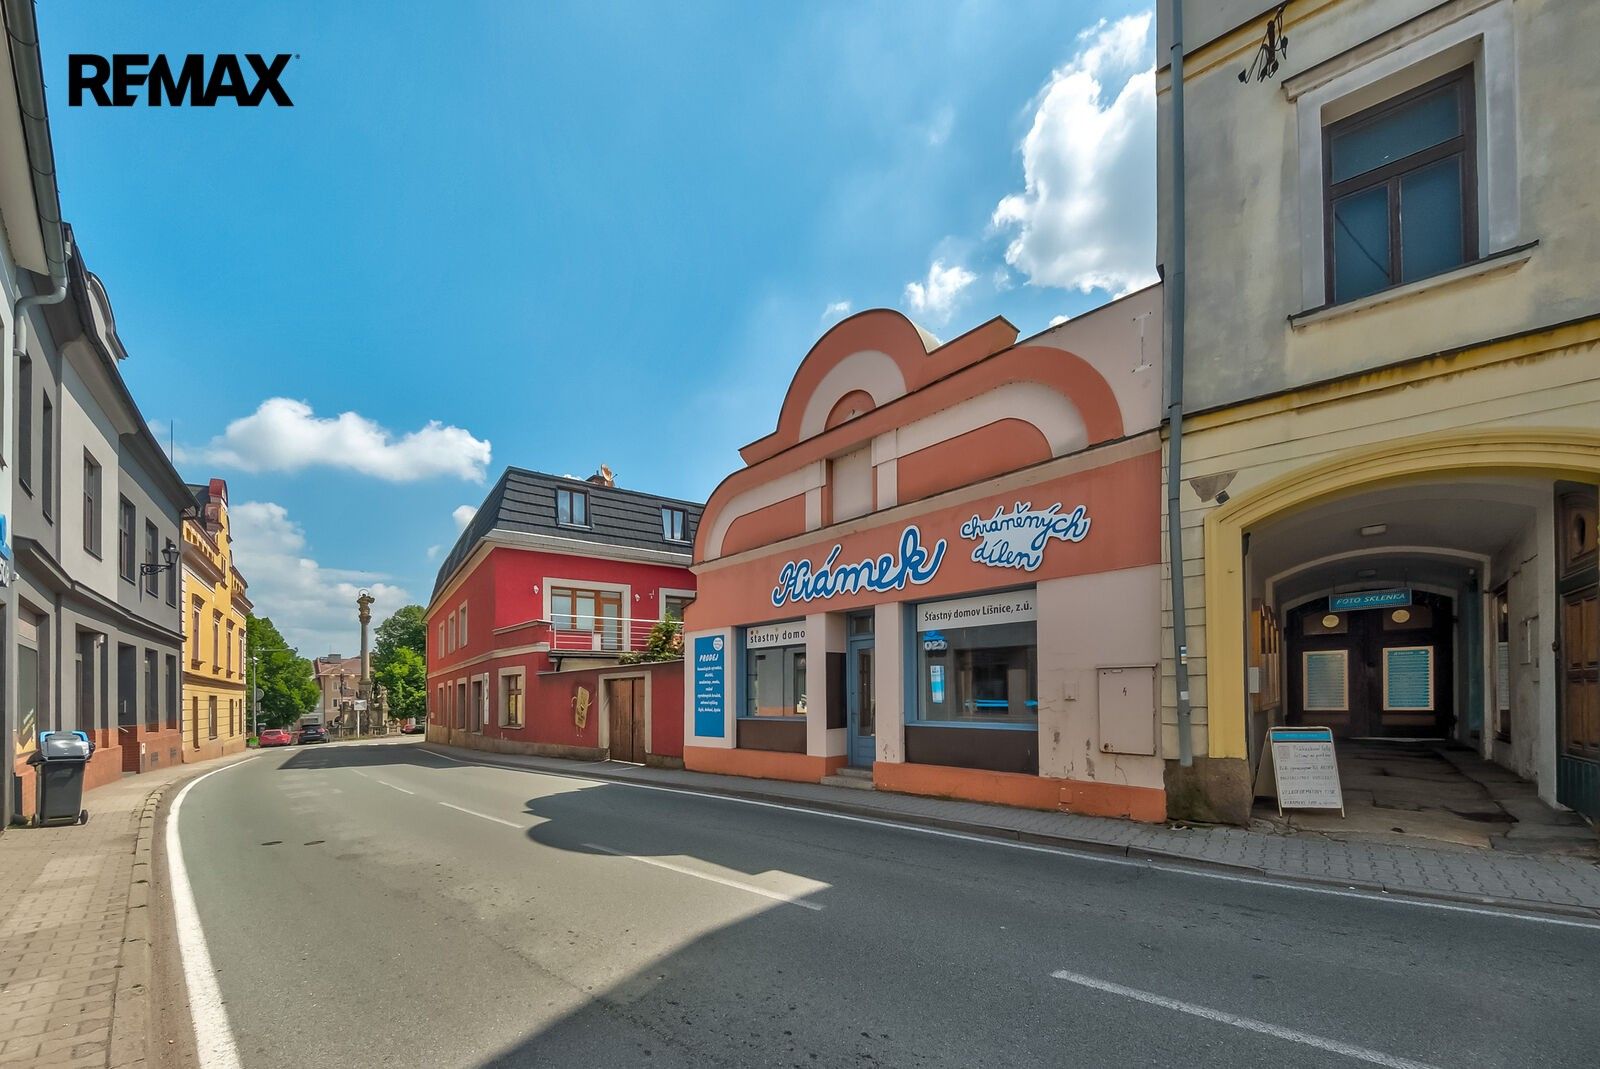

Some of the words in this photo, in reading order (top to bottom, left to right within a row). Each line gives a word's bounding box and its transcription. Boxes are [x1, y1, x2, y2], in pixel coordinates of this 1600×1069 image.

[962, 503, 1087, 550] chráněných
[975, 539, 1040, 568] dílen
[1336, 597, 1361, 605] FOTO
[1363, 593, 1406, 603] SKLENKA
[924, 610, 952, 622] Šťastný
[953, 608, 981, 619] domov
